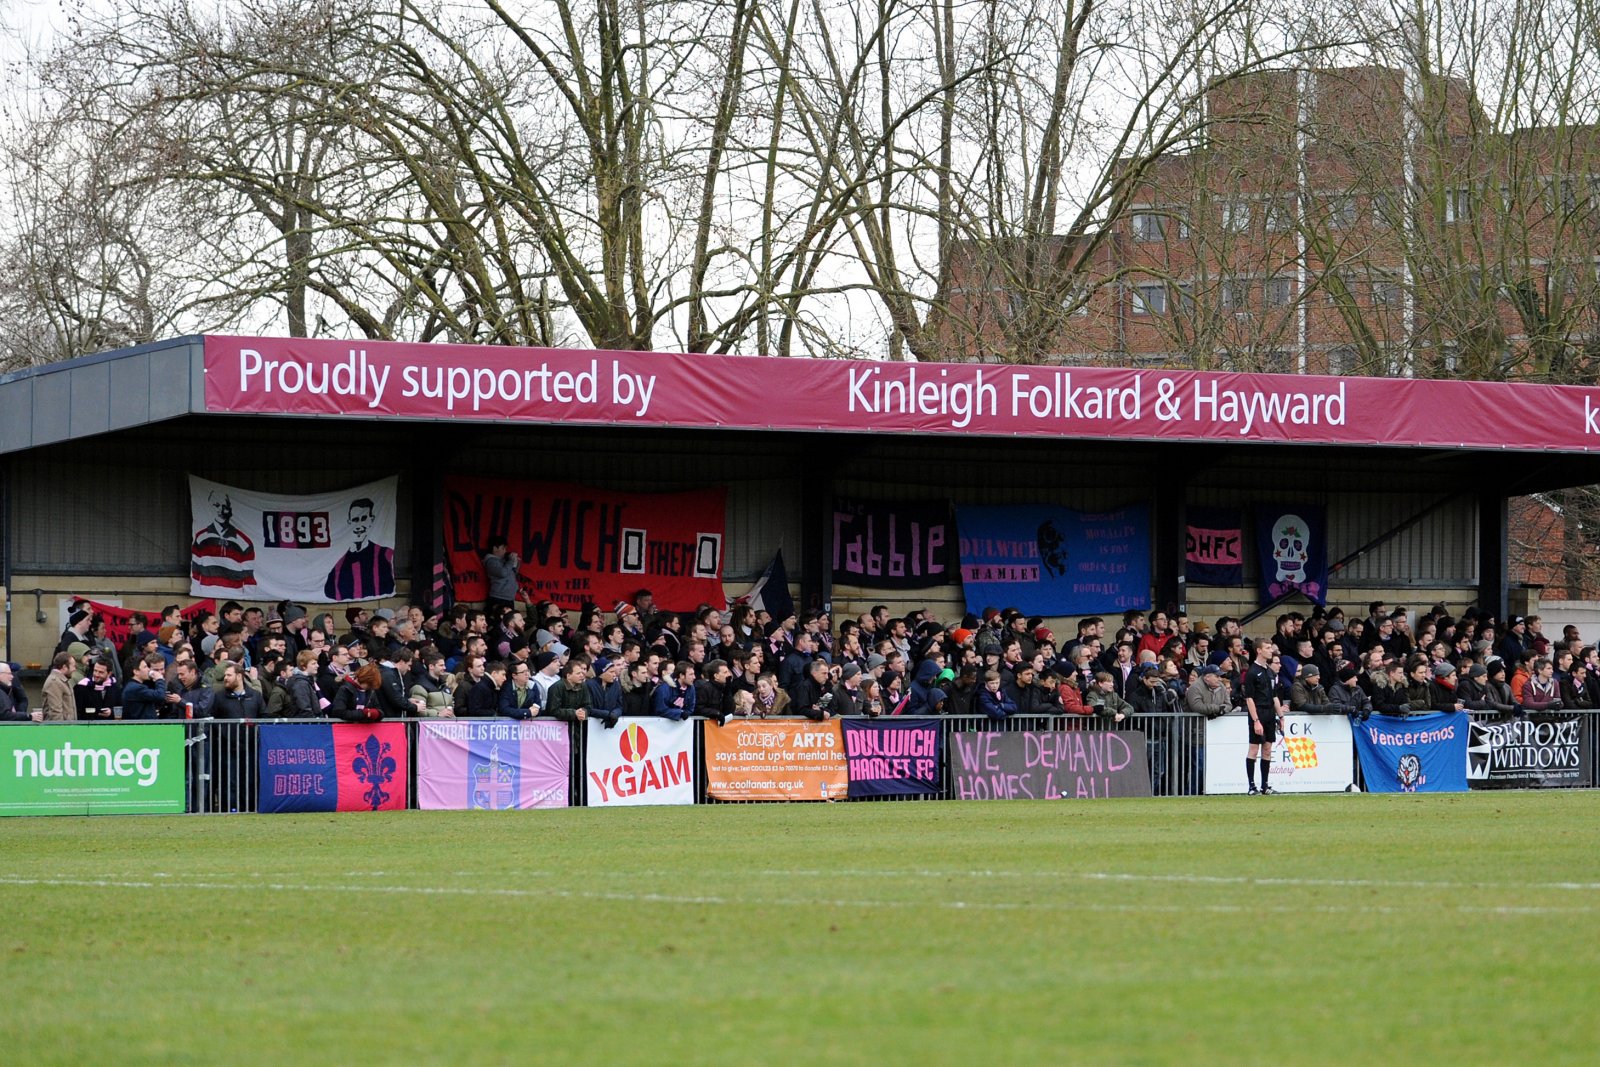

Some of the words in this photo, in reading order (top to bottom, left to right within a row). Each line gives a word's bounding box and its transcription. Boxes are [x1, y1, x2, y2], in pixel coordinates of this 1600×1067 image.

[240, 349, 390, 408] Proudly
[402, 359, 598, 410] supported
[612, 360, 656, 417] by
[848, 367, 997, 428] Kinleigh
[1012, 373, 1141, 421] Folkard
[1154, 378, 1182, 421] &
[1194, 379, 1346, 435] Hayward
[266, 514, 328, 544] 1893
[832, 511, 945, 577] rabble
[960, 536, 1038, 560] DULWICH
[1186, 533, 1238, 559] DHFC
[648, 540, 695, 577] THEM
[971, 567, 1038, 581] HAMLET
[1074, 582, 1120, 594] FOOTBALL
[424, 724, 476, 740] FOOTBALL
[478, 724, 488, 740] IS
[490, 724, 509, 740] FOR
[511, 724, 562, 741] EVERYONE
[792, 732, 835, 748] ARTS
[846, 728, 936, 757] DULWICH
[1370, 725, 1455, 746] Venceremos
[1487, 720, 1580, 747] BESPOKE
[13, 742, 160, 787] nutmeg
[268, 748, 326, 766] SEMPER
[716, 752, 736, 762] says
[739, 750, 765, 761] stand
[768, 752, 780, 762] up
[782, 750, 794, 760] for
[798, 750, 828, 760] mental
[955, 732, 1002, 773] WE
[1023, 732, 1131, 773] DEMAND
[1492, 746, 1580, 768] WINDOWS
[589, 751, 692, 803] YGAM
[849, 758, 911, 782] HAMLET
[916, 758, 935, 780] FC
[274, 774, 324, 796] DHFC
[711, 780, 804, 790] www.cooltanarts.org.uk
[958, 773, 1034, 800] HOMES
[1044, 772, 1062, 800] 4
